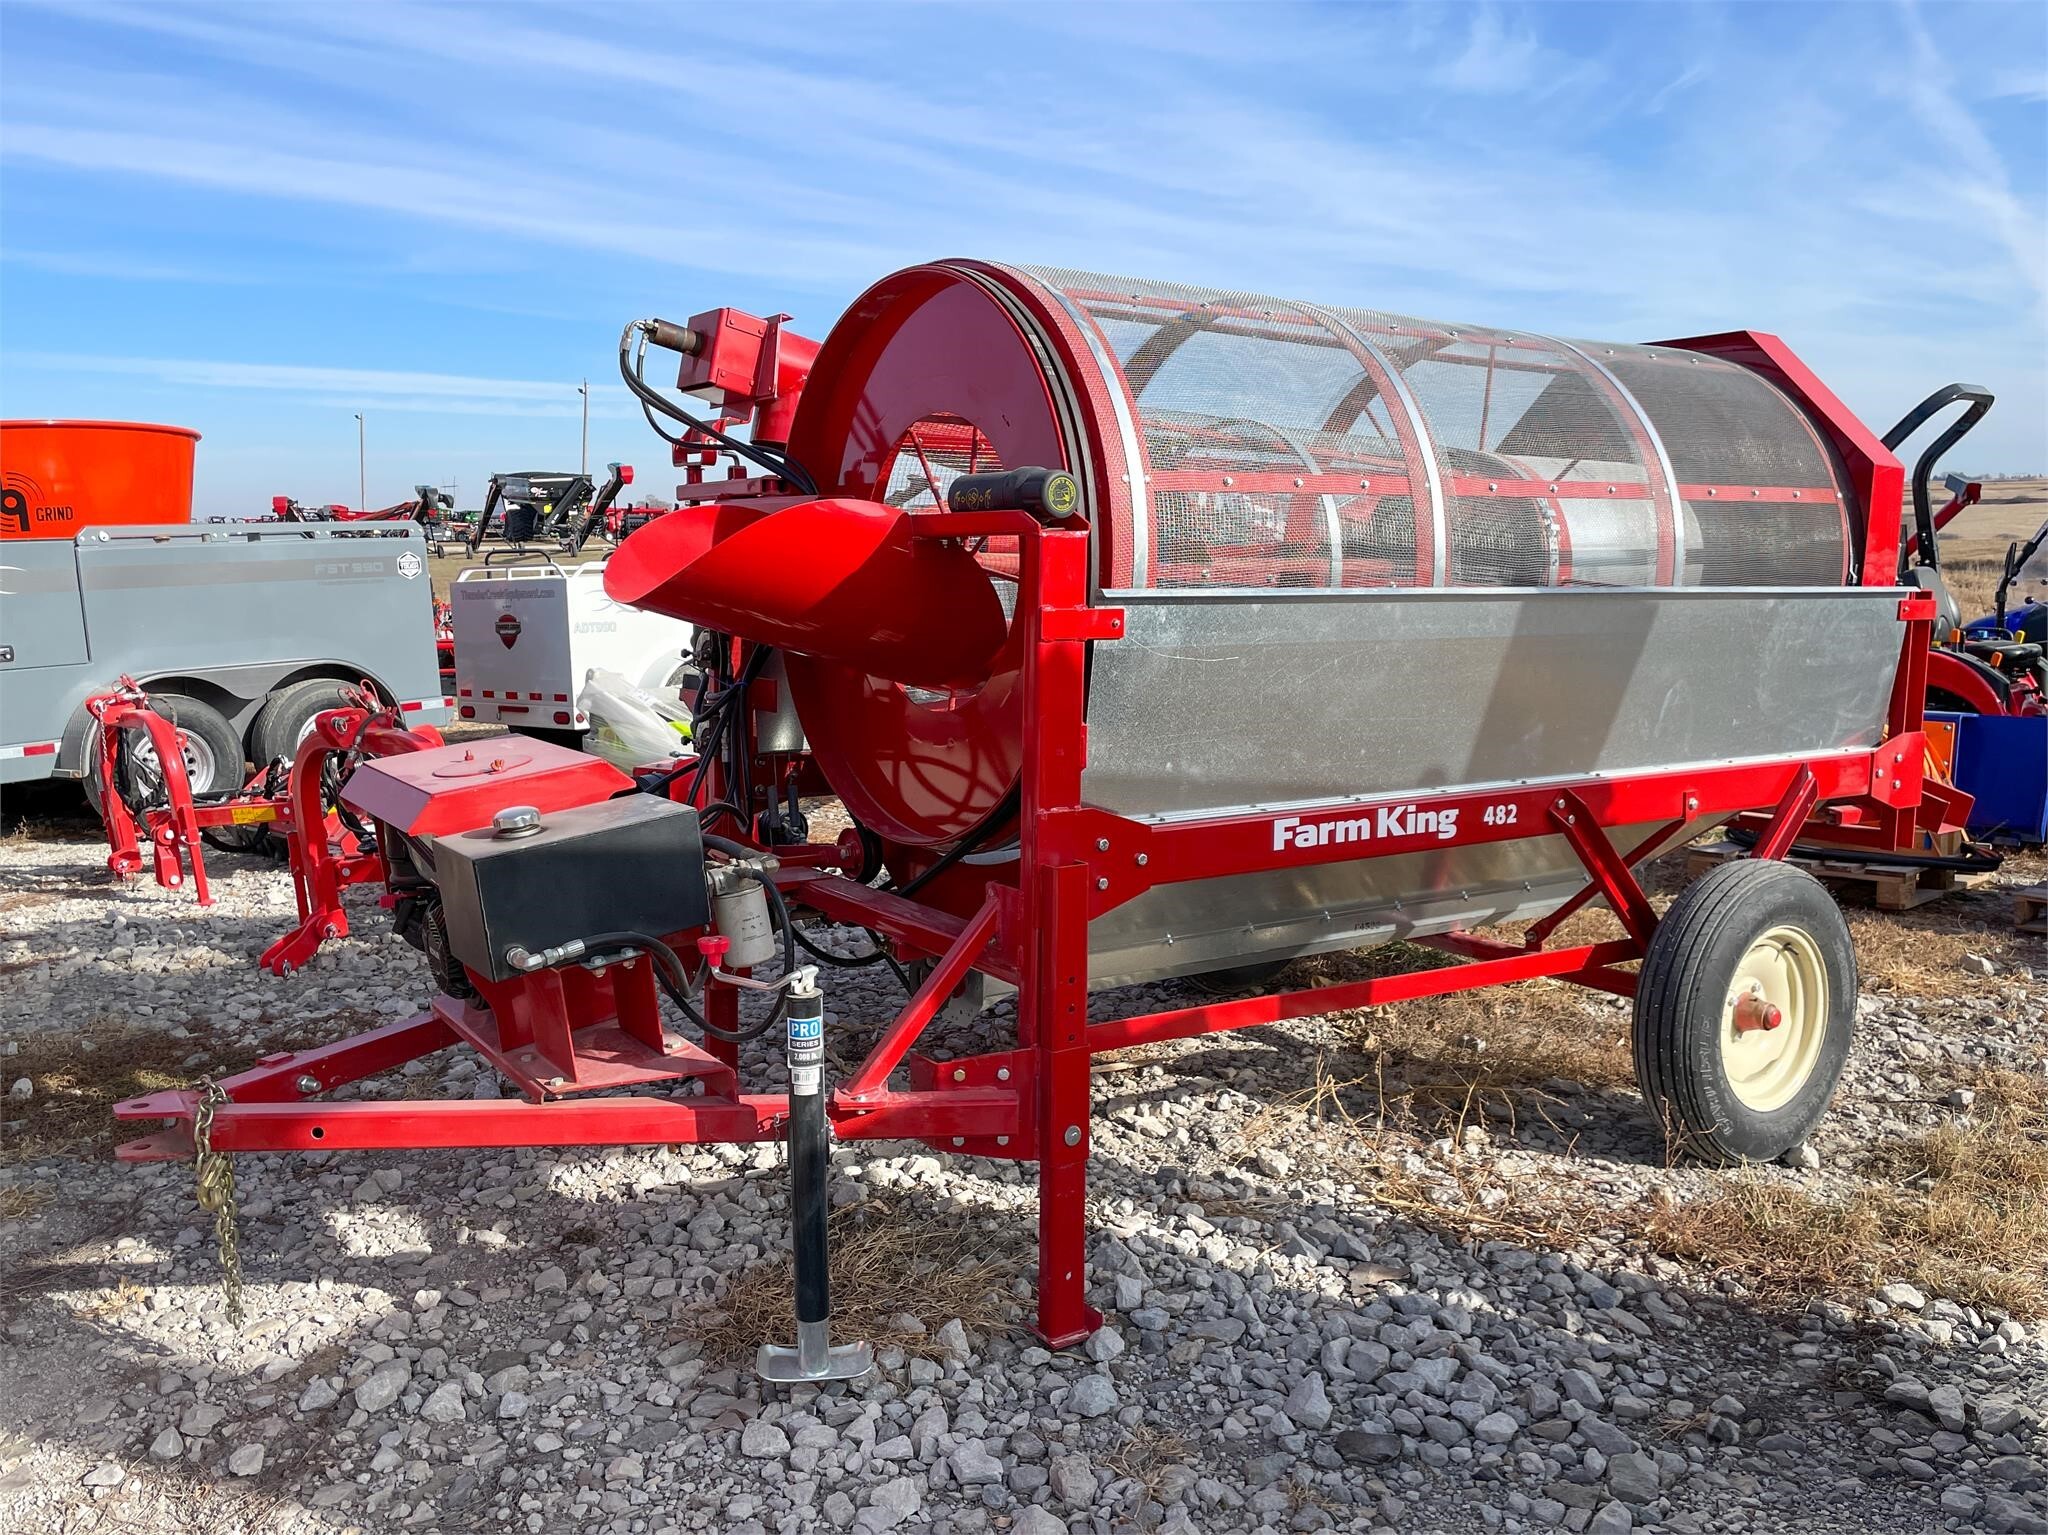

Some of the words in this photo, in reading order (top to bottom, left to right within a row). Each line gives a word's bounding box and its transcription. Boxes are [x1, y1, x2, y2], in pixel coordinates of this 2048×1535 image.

[36, 506, 73, 522] GRIND
[1273, 817, 1371, 852] Farm
[1377, 804, 1460, 840] King
[1483, 803, 1518, 827] 482
[791, 1021, 819, 1037] PRO
[792, 1040, 819, 1048] SERIES
